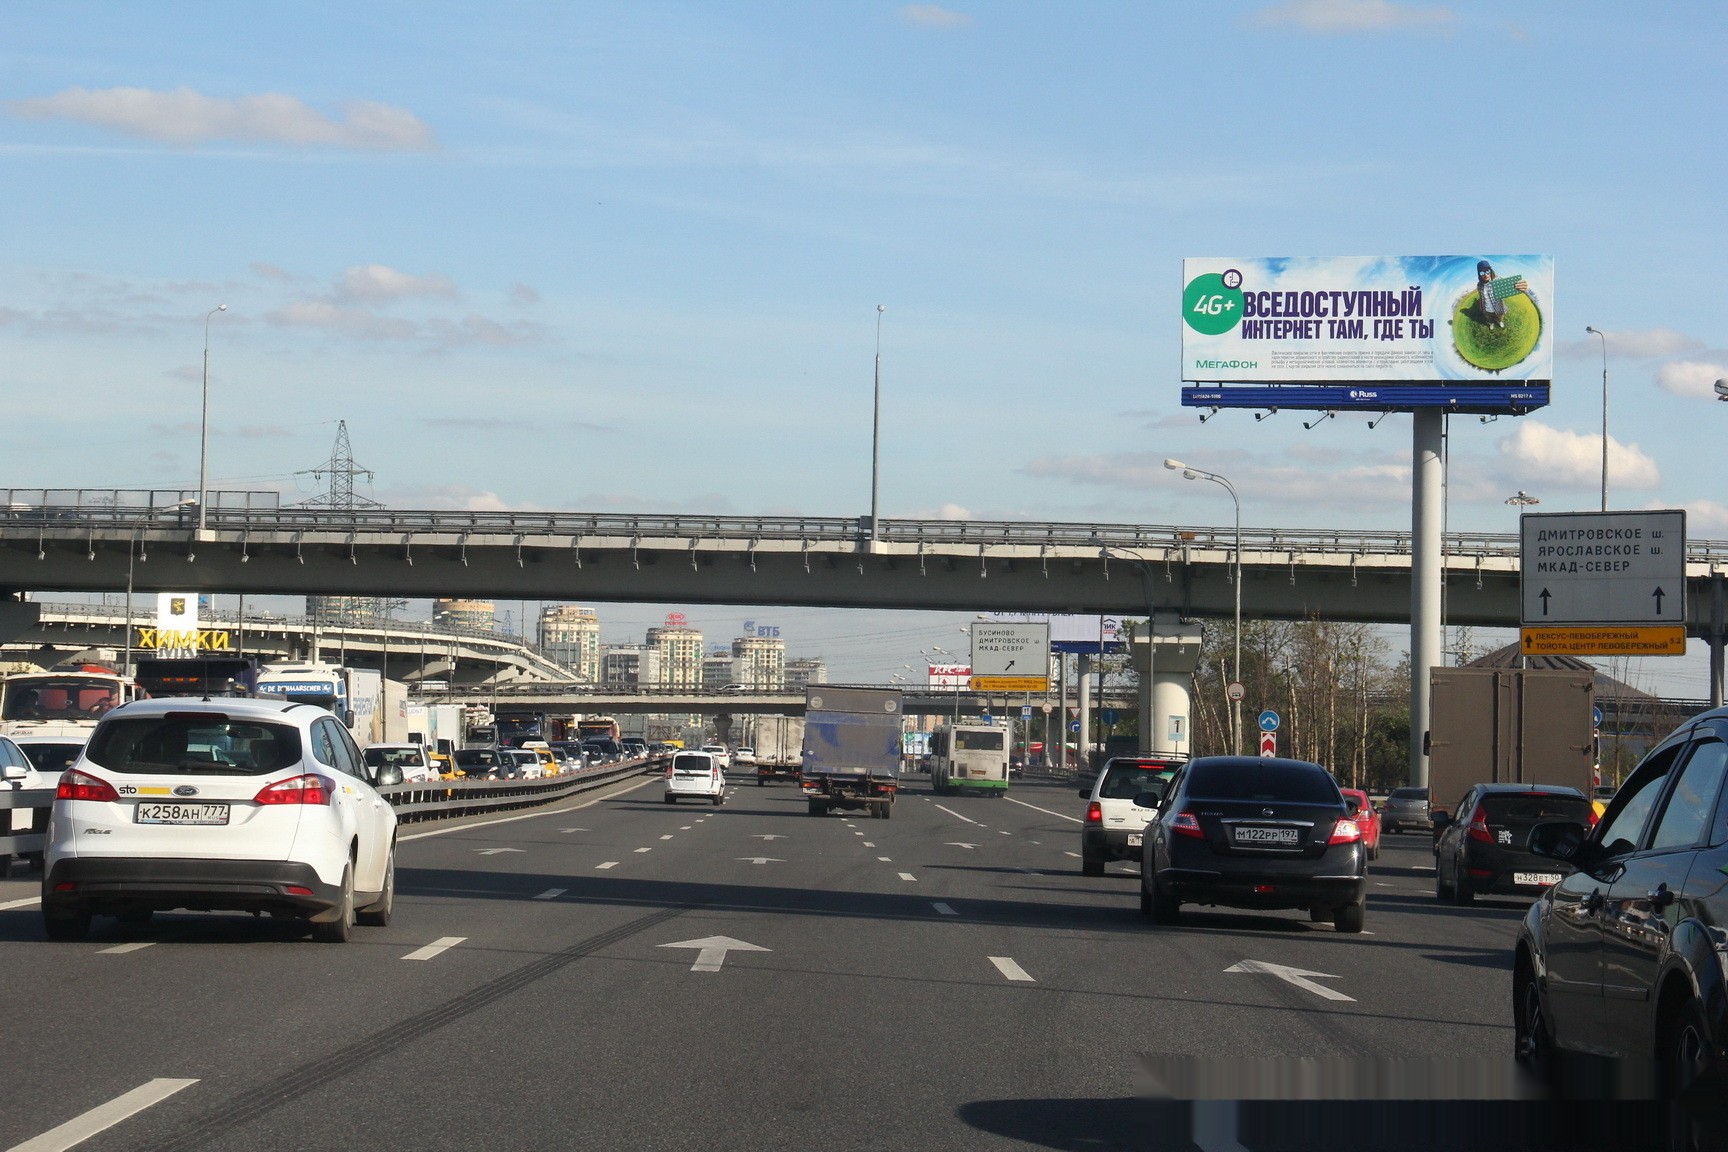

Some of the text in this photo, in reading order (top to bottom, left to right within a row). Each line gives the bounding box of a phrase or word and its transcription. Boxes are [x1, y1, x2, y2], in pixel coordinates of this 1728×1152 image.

[1193, 294, 1235, 316] 4G+
[1242, 285, 1422, 318] ВСЕДОСТУПНЫЙ
[1241, 318, 1434, 342] ИНТЕРНЕТ ТАМ, ГДЕ ТЫ
[1358, 390, 1378, 398] Russ
[1537, 528, 1642, 542] ДМИТРОВСКОЕ
[1538, 544, 1641, 557] ЯРОСЛАВСКОЕ
[1537, 560, 1630, 573] МКАД-СЕВЕР
[757, 625, 780, 637] ВТБ
[1535, 631, 1639, 640] ЛЕКСУС-ЛЕВОБЕРЕЖНЫЙ
[138, 627, 229, 651] ХИМКИ
[1536, 642, 1567, 650] ТОЙОТА
[1598, 642, 1668, 650] ЛЕВОБЕРЕЖНЫЙ
[118, 784, 137, 794] sto
[142, 805, 225, 820] К258АН 777
[1280, 829, 1296, 838] 197
